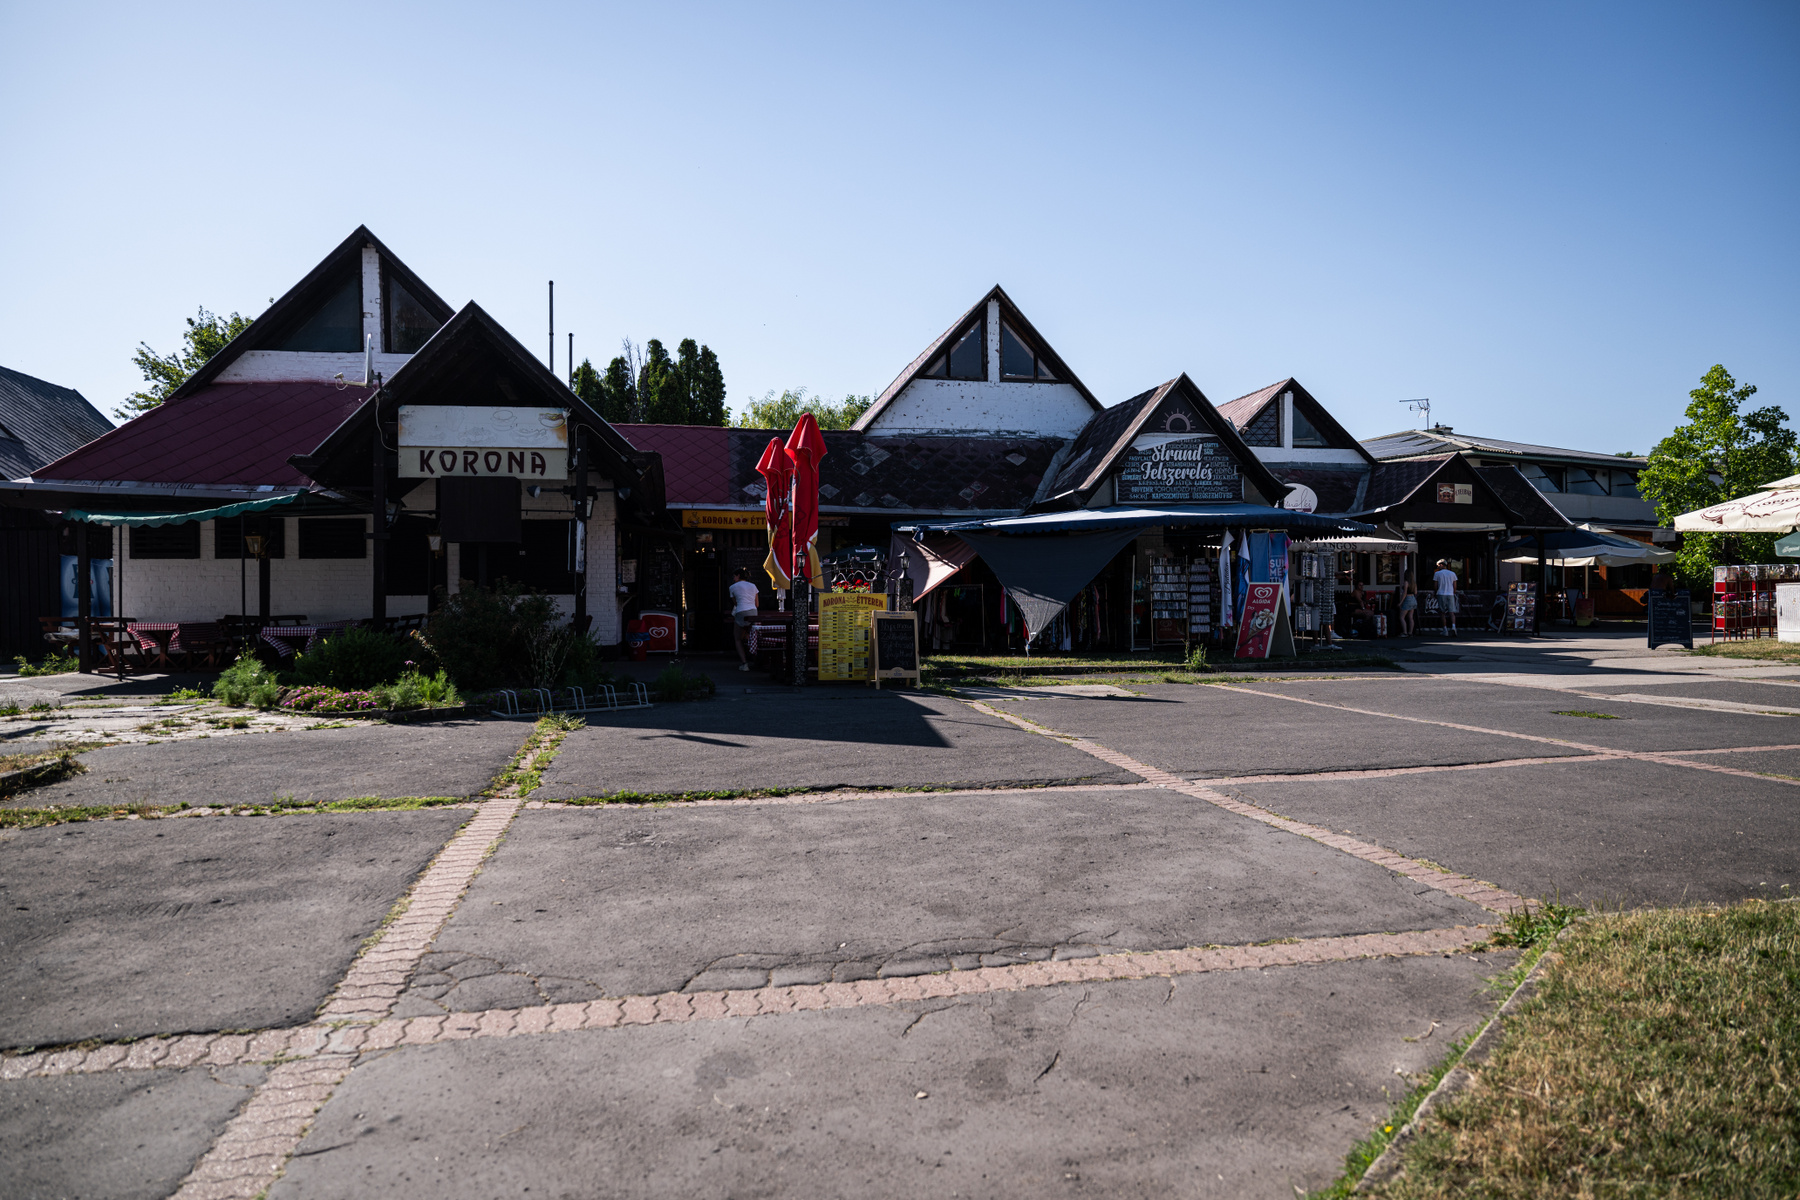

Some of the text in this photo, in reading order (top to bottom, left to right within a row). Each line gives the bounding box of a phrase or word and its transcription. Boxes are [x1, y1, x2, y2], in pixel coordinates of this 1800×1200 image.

[1152, 443, 1203, 462] Strand
[420, 450, 546, 476] KORONA
[1140, 461, 1213, 486] Felszerelés
[702, 514, 767, 525] KORONA ÉTT
[822, 596, 846, 608] KORONA
[856, 594, 884, 608] ÉTTEREM
